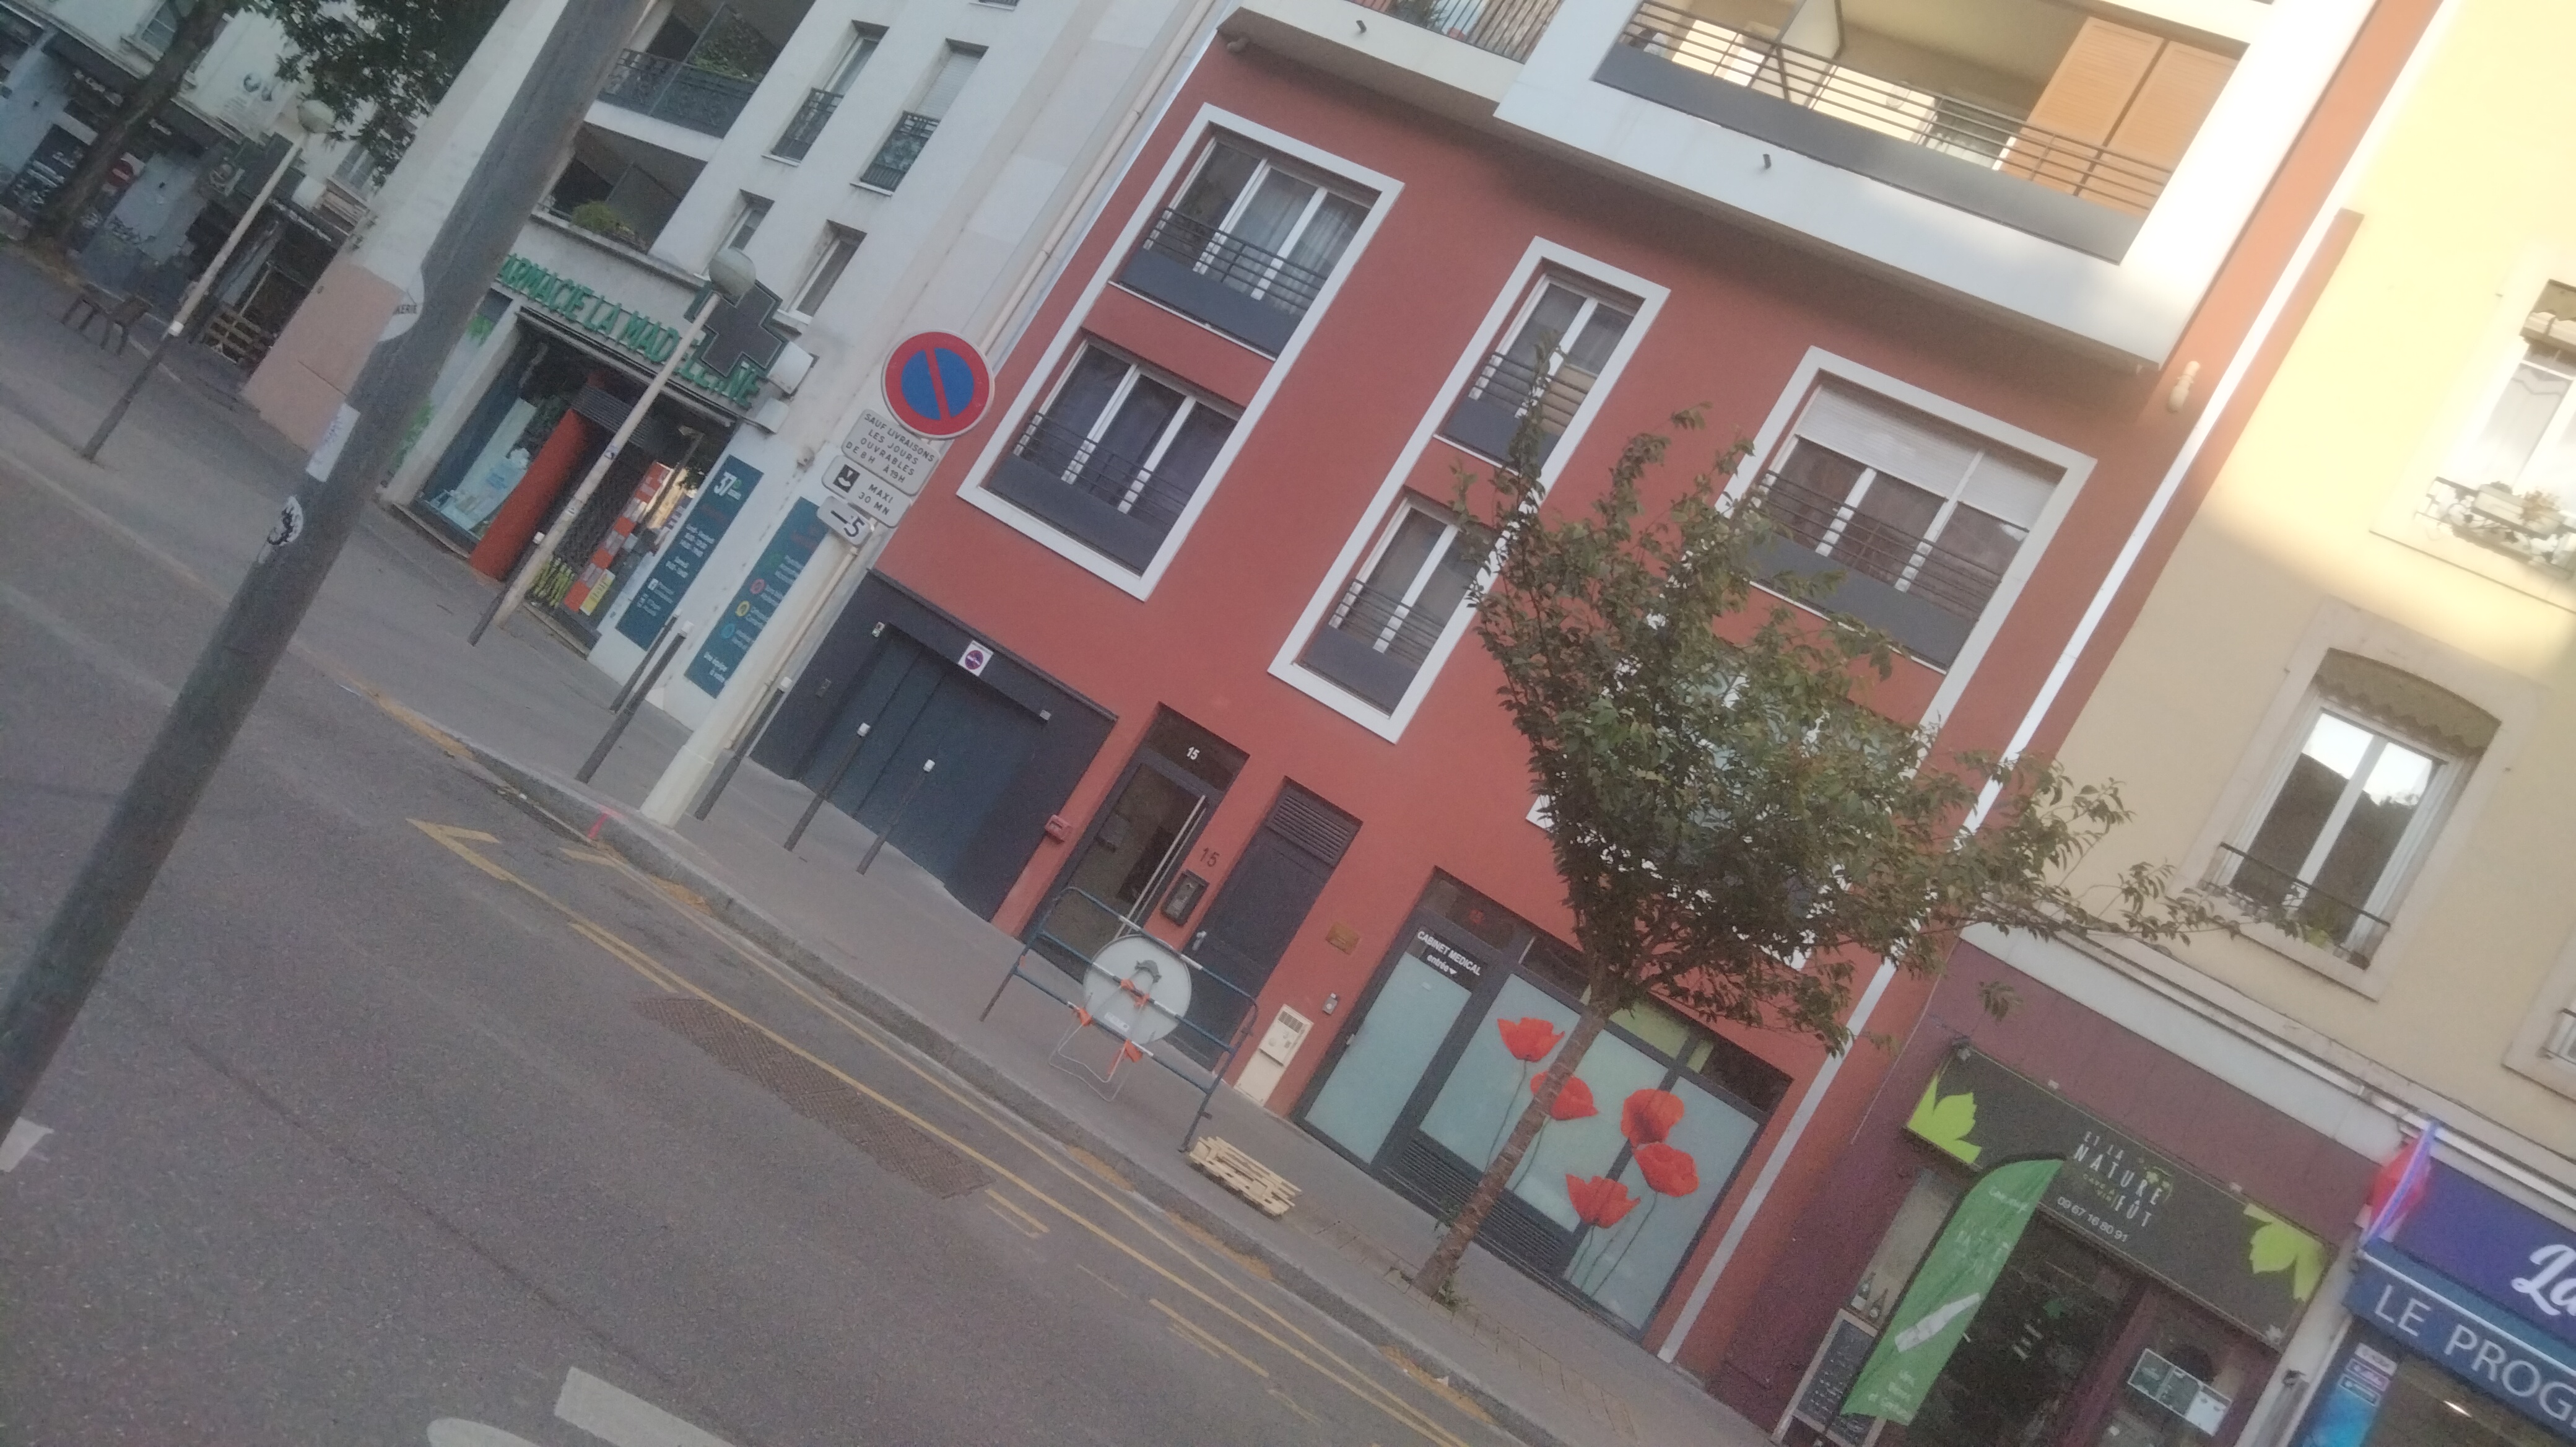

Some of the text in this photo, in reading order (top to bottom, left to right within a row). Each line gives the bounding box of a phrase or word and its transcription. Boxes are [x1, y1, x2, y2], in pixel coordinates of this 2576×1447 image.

[496, 253, 594, 322] ARMACIE
[583, 295, 622, 336] LA
[845, 441, 859, 454] DE
[864, 413, 935, 462] SAUF LIVRAISONS
[868, 429, 919, 465] LES JOURS
[860, 437, 915, 476] OUVRABLES
[858, 492, 890, 515] 30 MN
[868, 484, 894, 504] MAXI
[1186, 746, 1200, 760] 15
[1199, 847, 1221, 868] 15
[1417, 931, 1481, 976] CABINET MEDICAL
[1427, 955, 1450, 972] entrée
[2084, 1131, 2124, 1160] ET LA
[2074, 1143, 2163, 1205] NATURE
[2057, 1196, 2128, 1243] 09 67 16 80 91
[2114, 1195, 2152, 1227] FÛT
[2374, 1284, 2576, 1428] LE PROG
